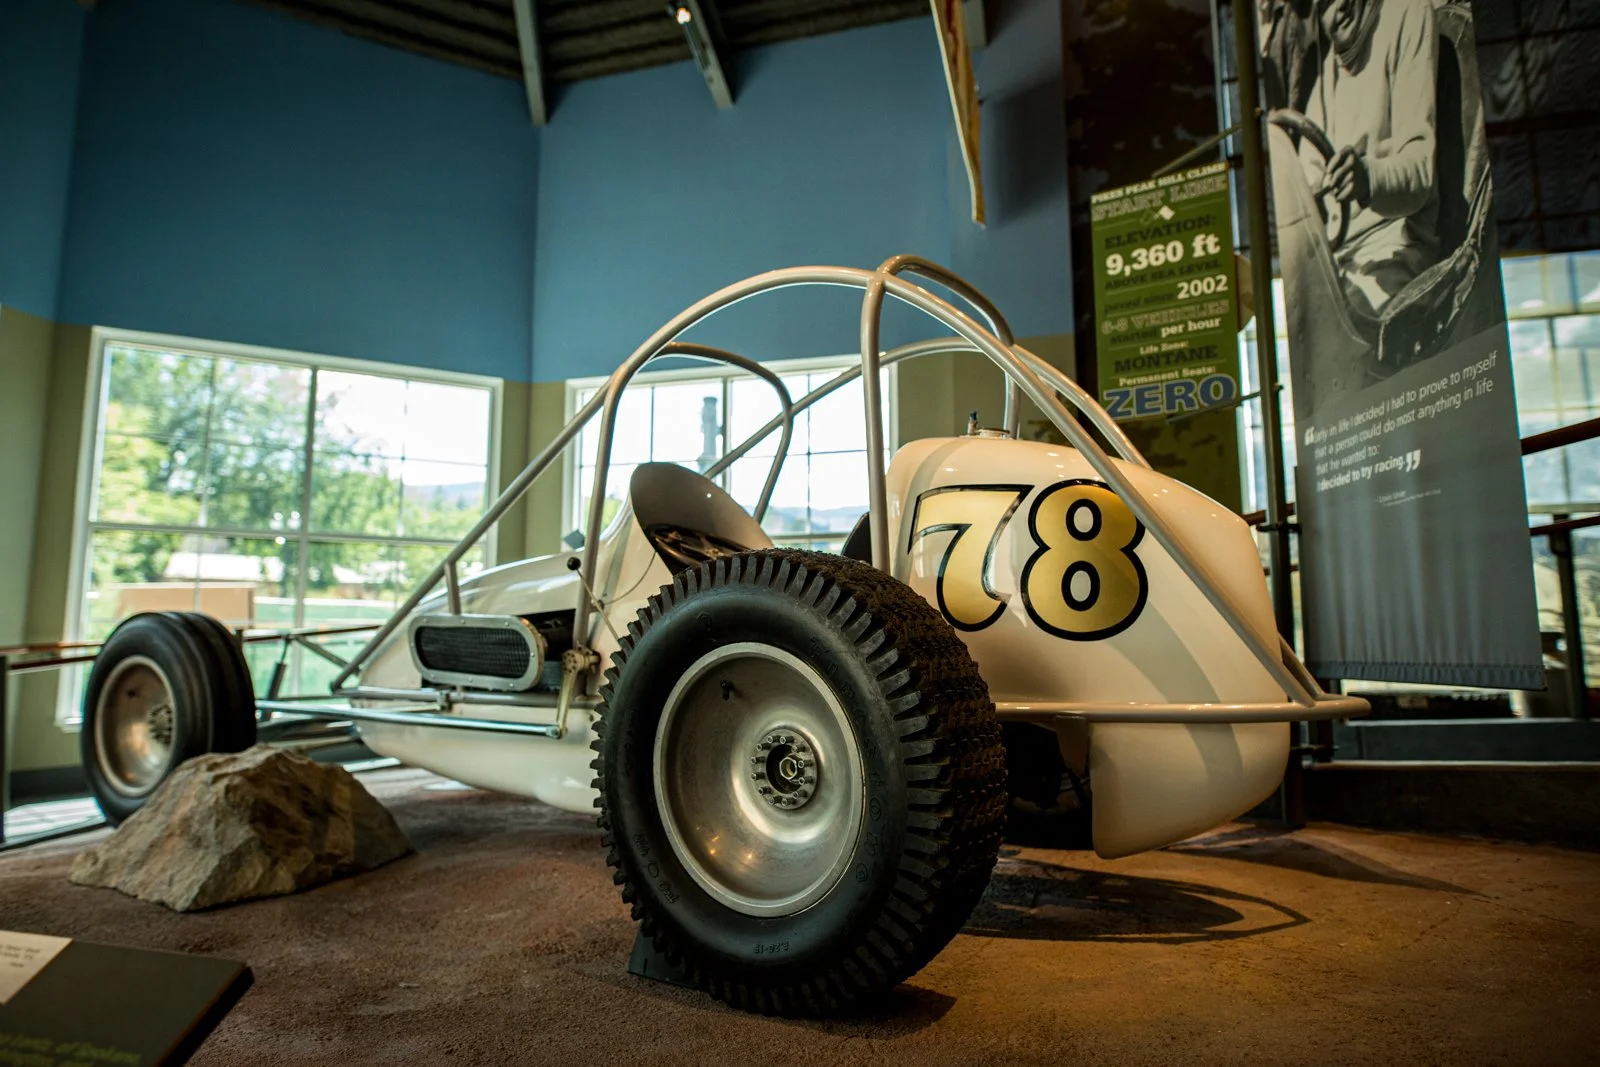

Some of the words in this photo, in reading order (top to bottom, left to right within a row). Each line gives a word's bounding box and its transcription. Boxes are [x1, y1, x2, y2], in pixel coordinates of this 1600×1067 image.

[1091, 188, 1166, 222] START
[1170, 174, 1227, 203] LINE
[1125, 180, 1156, 196] PEAK
[1158, 173, 1185, 187] HILL
[1105, 215, 1217, 249] ELEVATION:
[1106, 240, 1184, 277] 9,360
[1192, 233, 1221, 258] ft
[1105, 273, 1148, 290] ABOVE
[1151, 266, 1176, 280] SEA
[1177, 274, 1228, 300] 2002
[1131, 300, 1230, 328] VEHICLES
[1160, 324, 1185, 338] per
[1187, 318, 1222, 332] hour
[1114, 345, 1217, 373] MONTANE
[1119, 370, 1180, 386] Permanent
[1354, 400, 1385, 426] decided
[1391, 391, 1405, 411] had
[1406, 390, 1417, 403] to
[1419, 377, 1448, 401] prove
[1450, 371, 1461, 385] to
[1462, 350, 1498, 380] myself
[1103, 373, 1237, 420] ZERO
[1359, 421, 1382, 442] could
[1383, 417, 1395, 434] do
[1396, 409, 1415, 428] most
[1417, 393, 1461, 418] anything
[1464, 386, 1473, 401] in
[1476, 377, 1493, 396] life
[1320, 469, 1350, 492] decided
[1351, 470, 1360, 481] to
[1361, 465, 1373, 480] try
[907, 478, 1149, 642] 78
